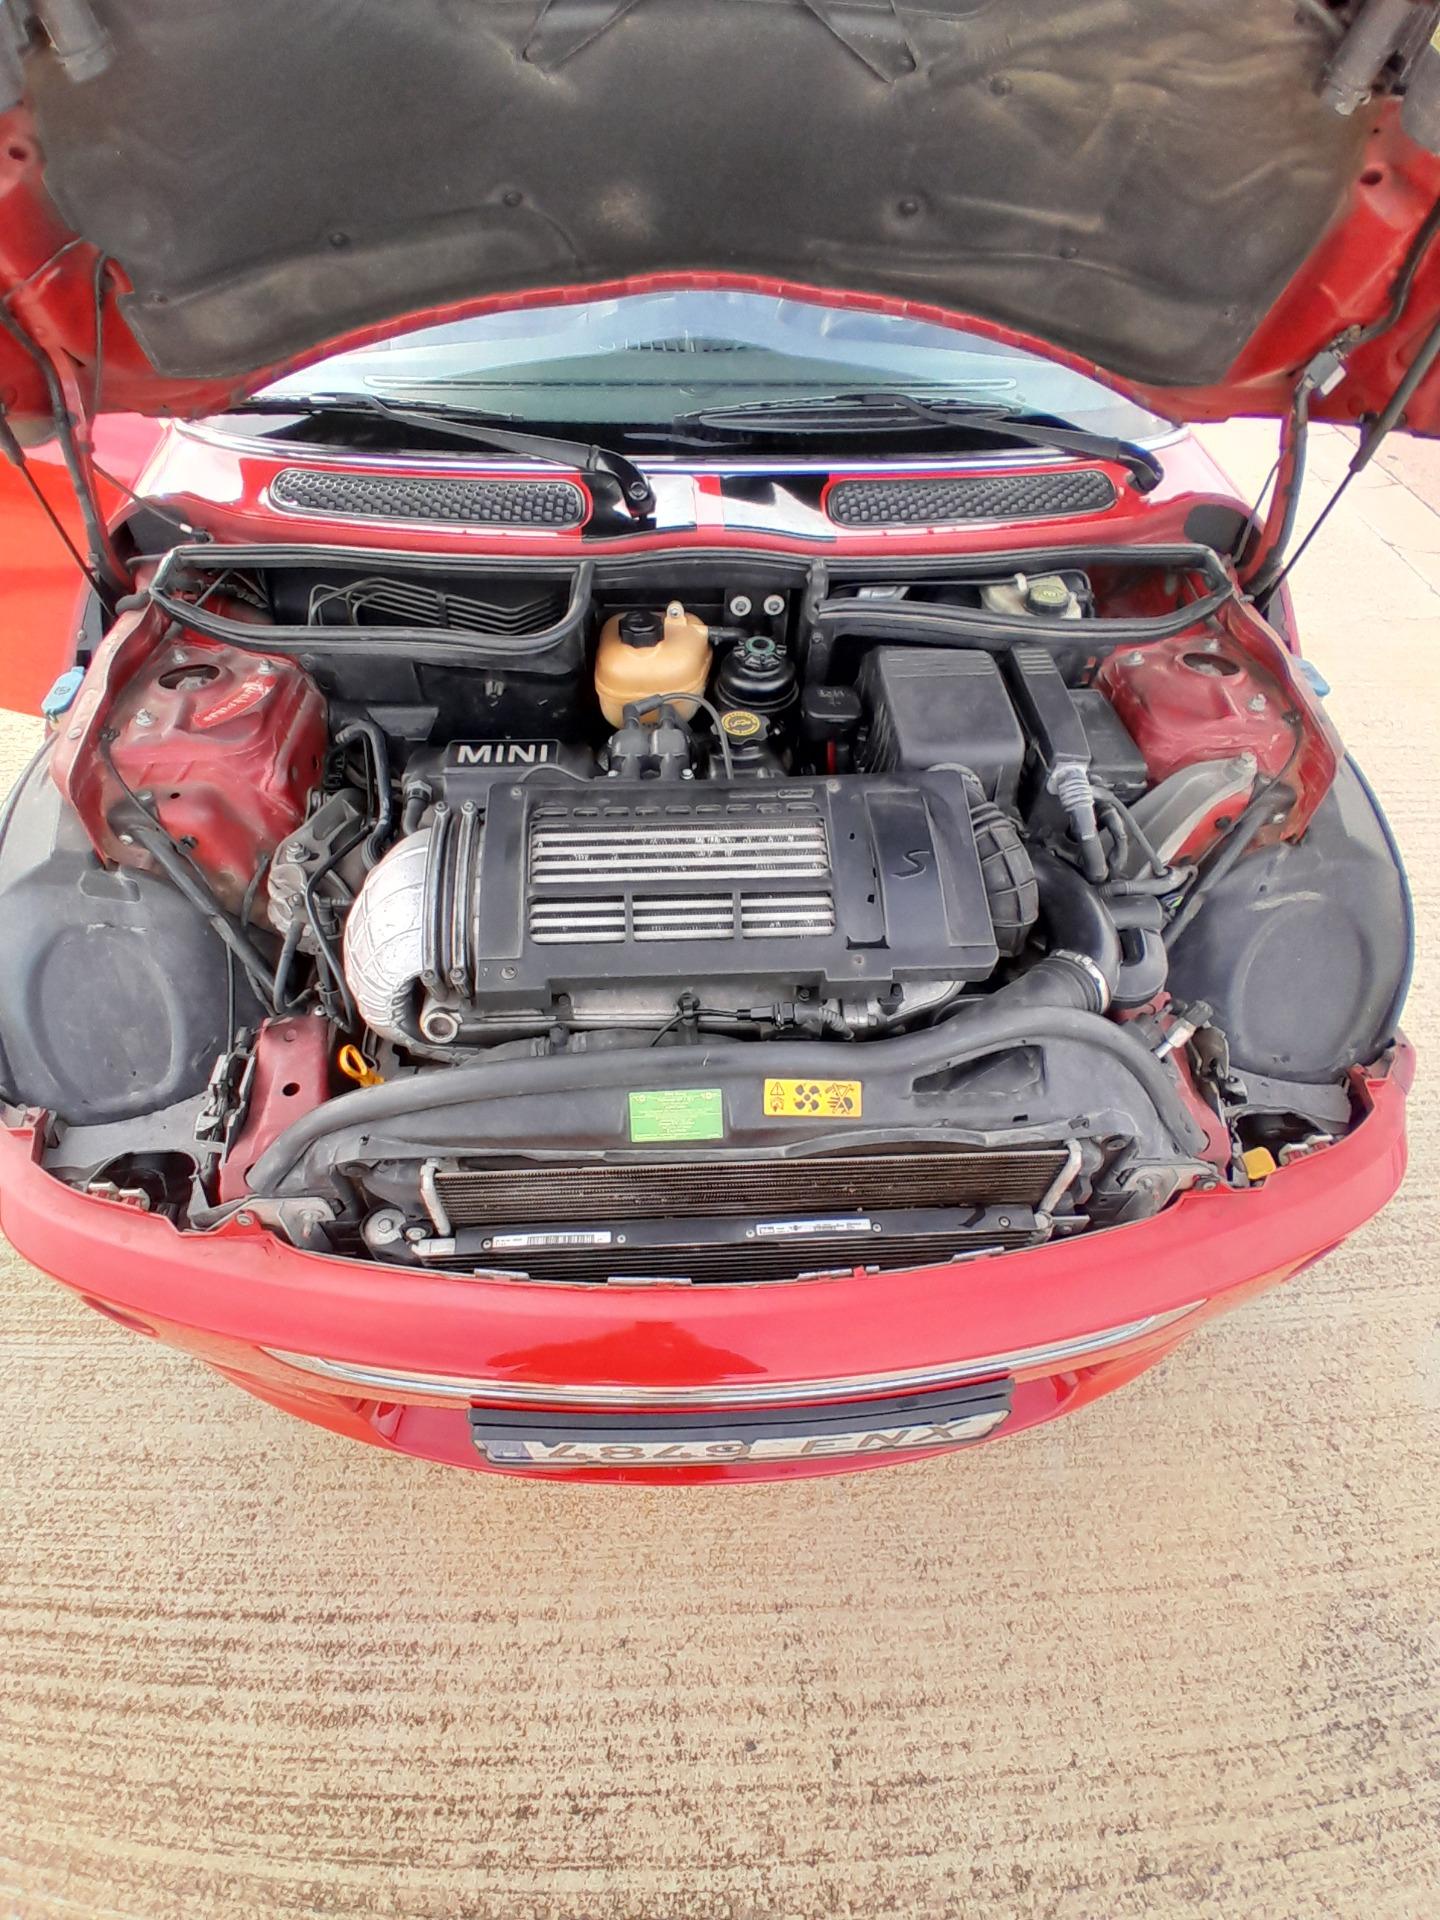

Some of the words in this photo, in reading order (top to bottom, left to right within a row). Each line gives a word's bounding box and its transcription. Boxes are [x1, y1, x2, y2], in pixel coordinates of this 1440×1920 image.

[457, 744, 548, 763] MINI
[548, 1443, 752, 1461] 4849
[800, 1420, 972, 1454] FNX
